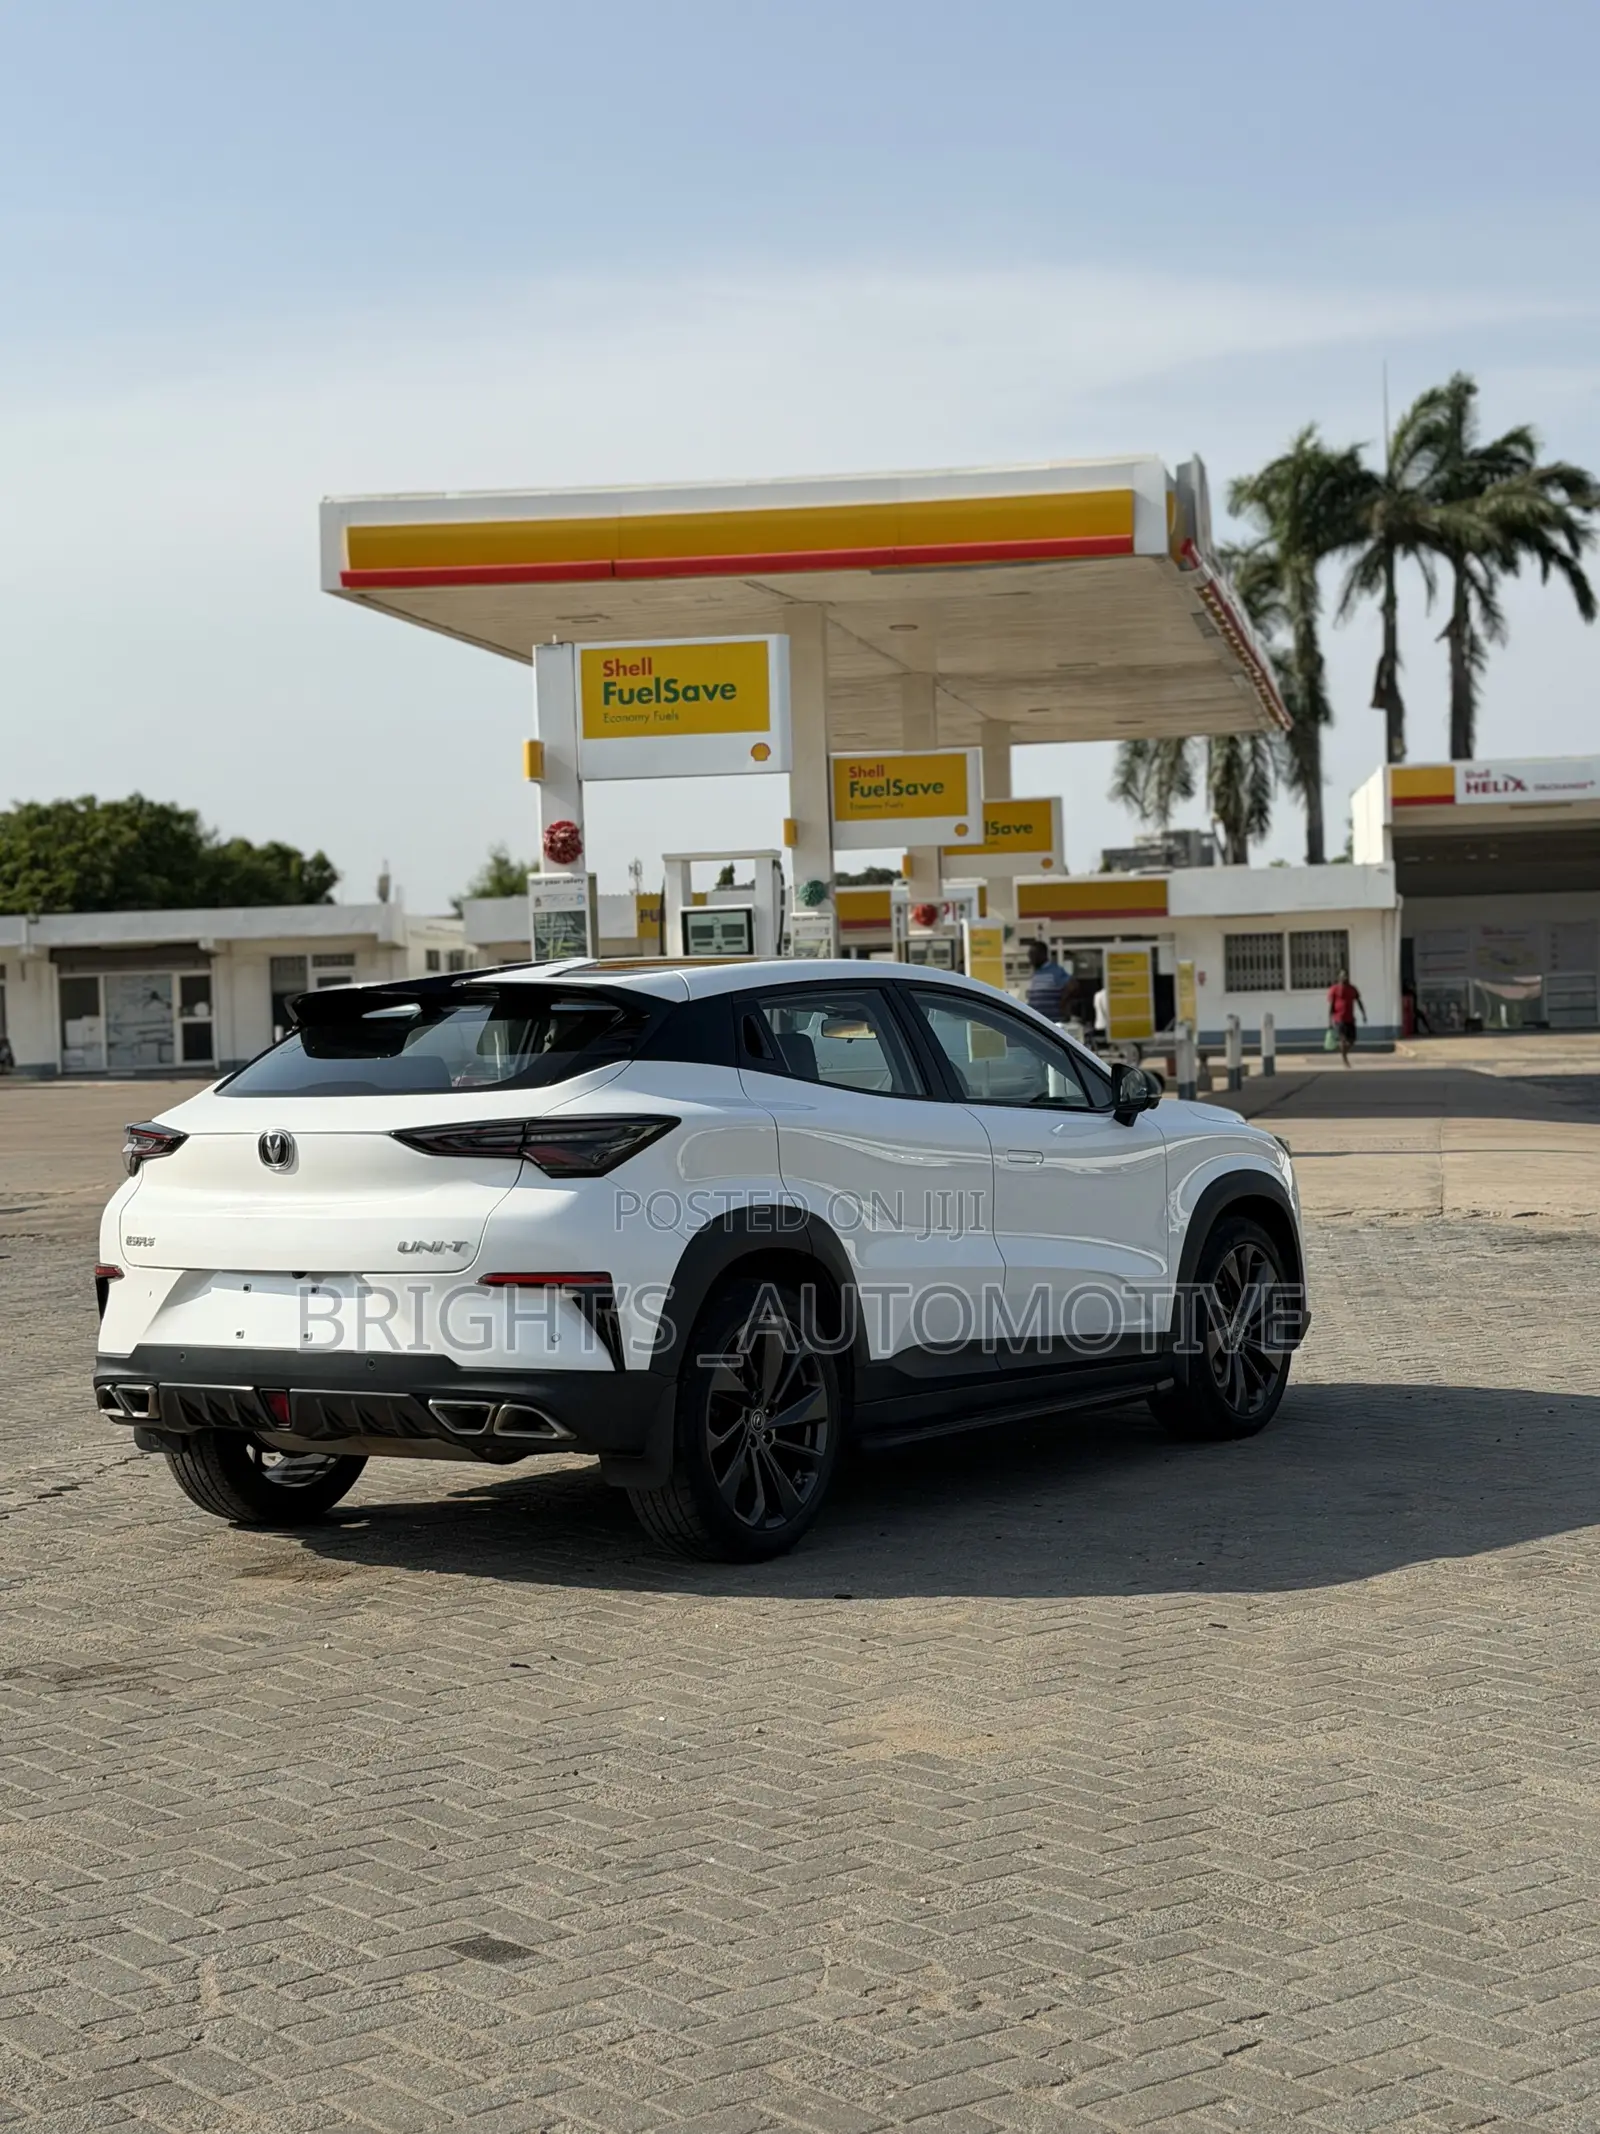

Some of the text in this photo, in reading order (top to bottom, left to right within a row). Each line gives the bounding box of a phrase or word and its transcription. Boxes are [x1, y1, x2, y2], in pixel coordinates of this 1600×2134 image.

[603, 657, 652, 677] Shell
[603, 677, 737, 706] FuelSave
[603, 709, 679, 724] Economy Fuels
[849, 764, 884, 779] Shell
[849, 778, 945, 798] FuelSave
[1465, 775, 1528, 793] HELIX
[984, 820, 1034, 836] lSave
[397, 1240, 469, 1254] UNI-T
